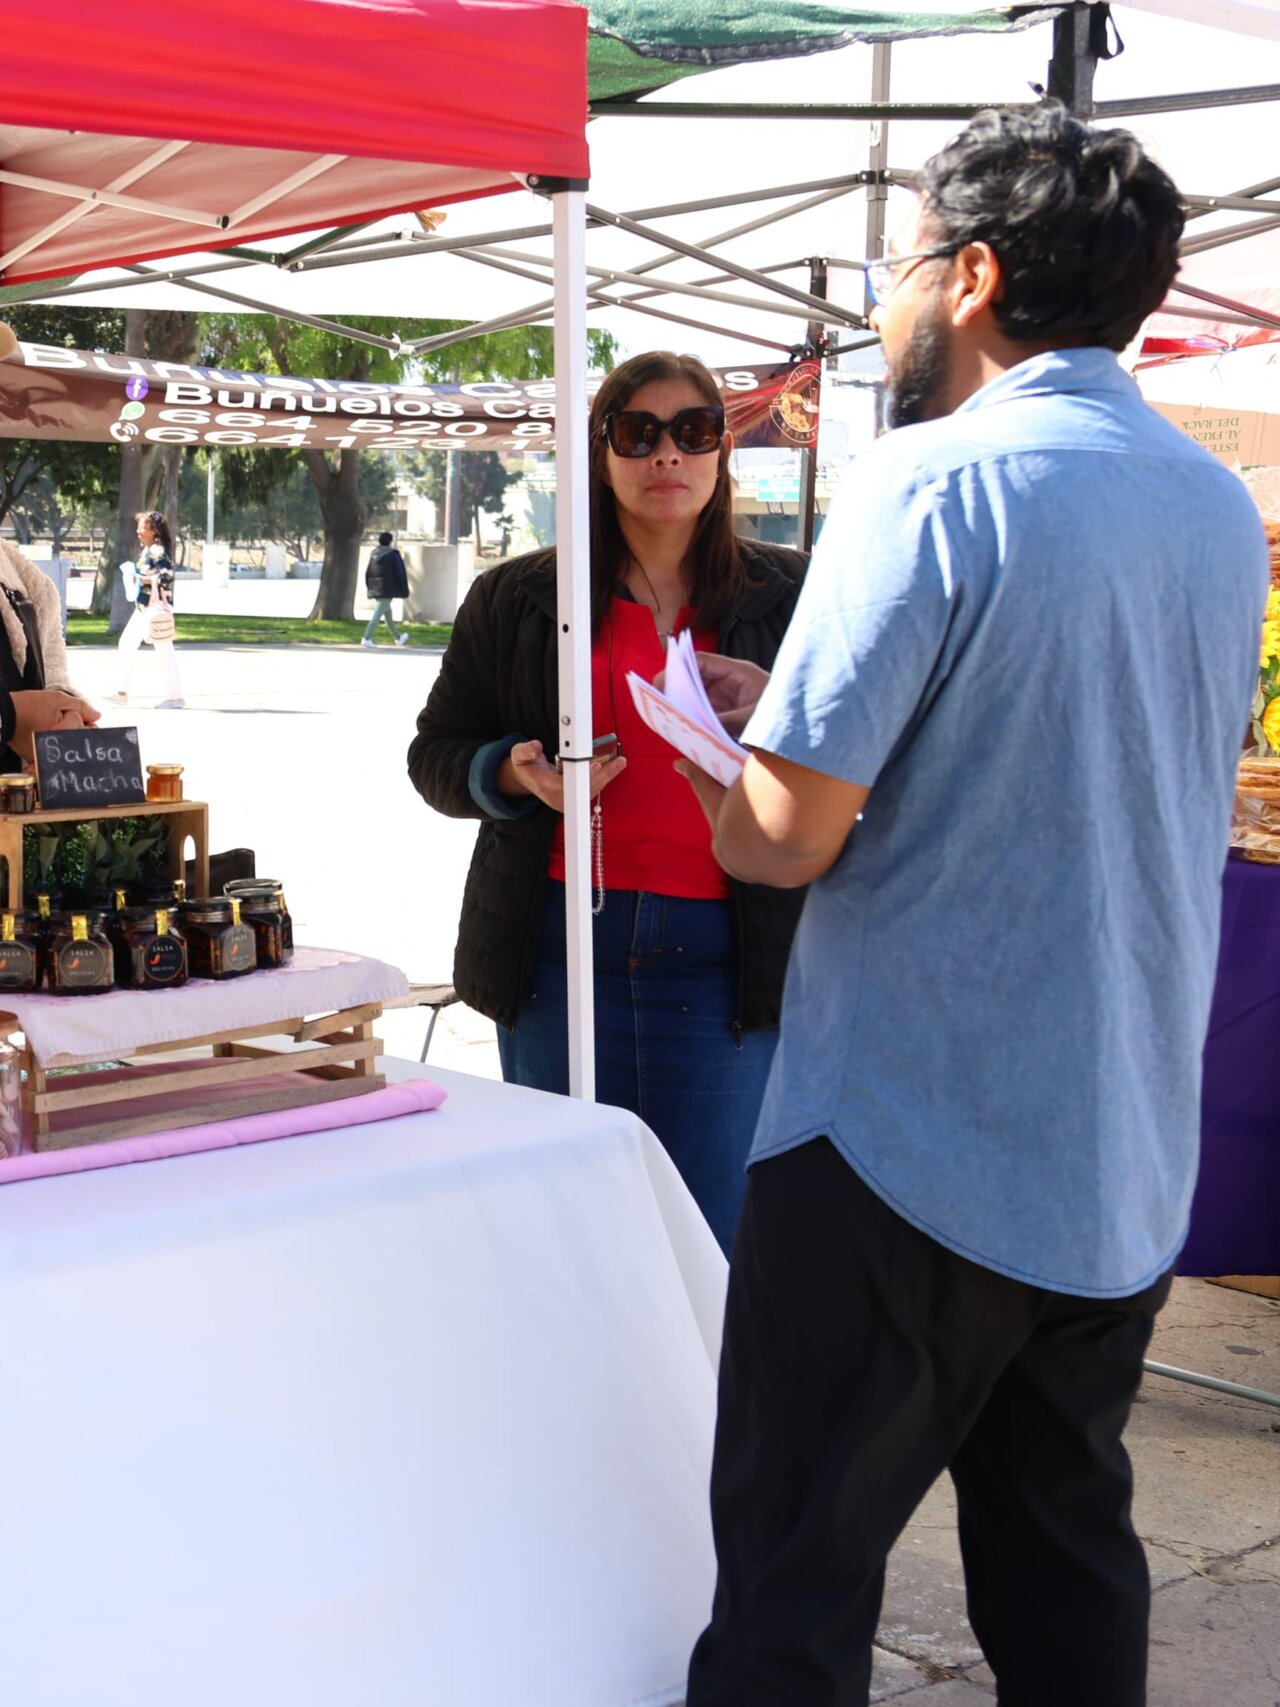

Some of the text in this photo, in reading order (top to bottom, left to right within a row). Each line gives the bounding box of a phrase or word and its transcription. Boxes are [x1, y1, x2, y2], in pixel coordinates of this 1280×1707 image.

[165, 382, 464, 417] Buñuelos
[158, 408, 554, 437] 664 520 8
[1218, 417, 1240, 427] DEL
[44, 736, 123, 763] Salsa
[55, 769, 143, 793] Macha
